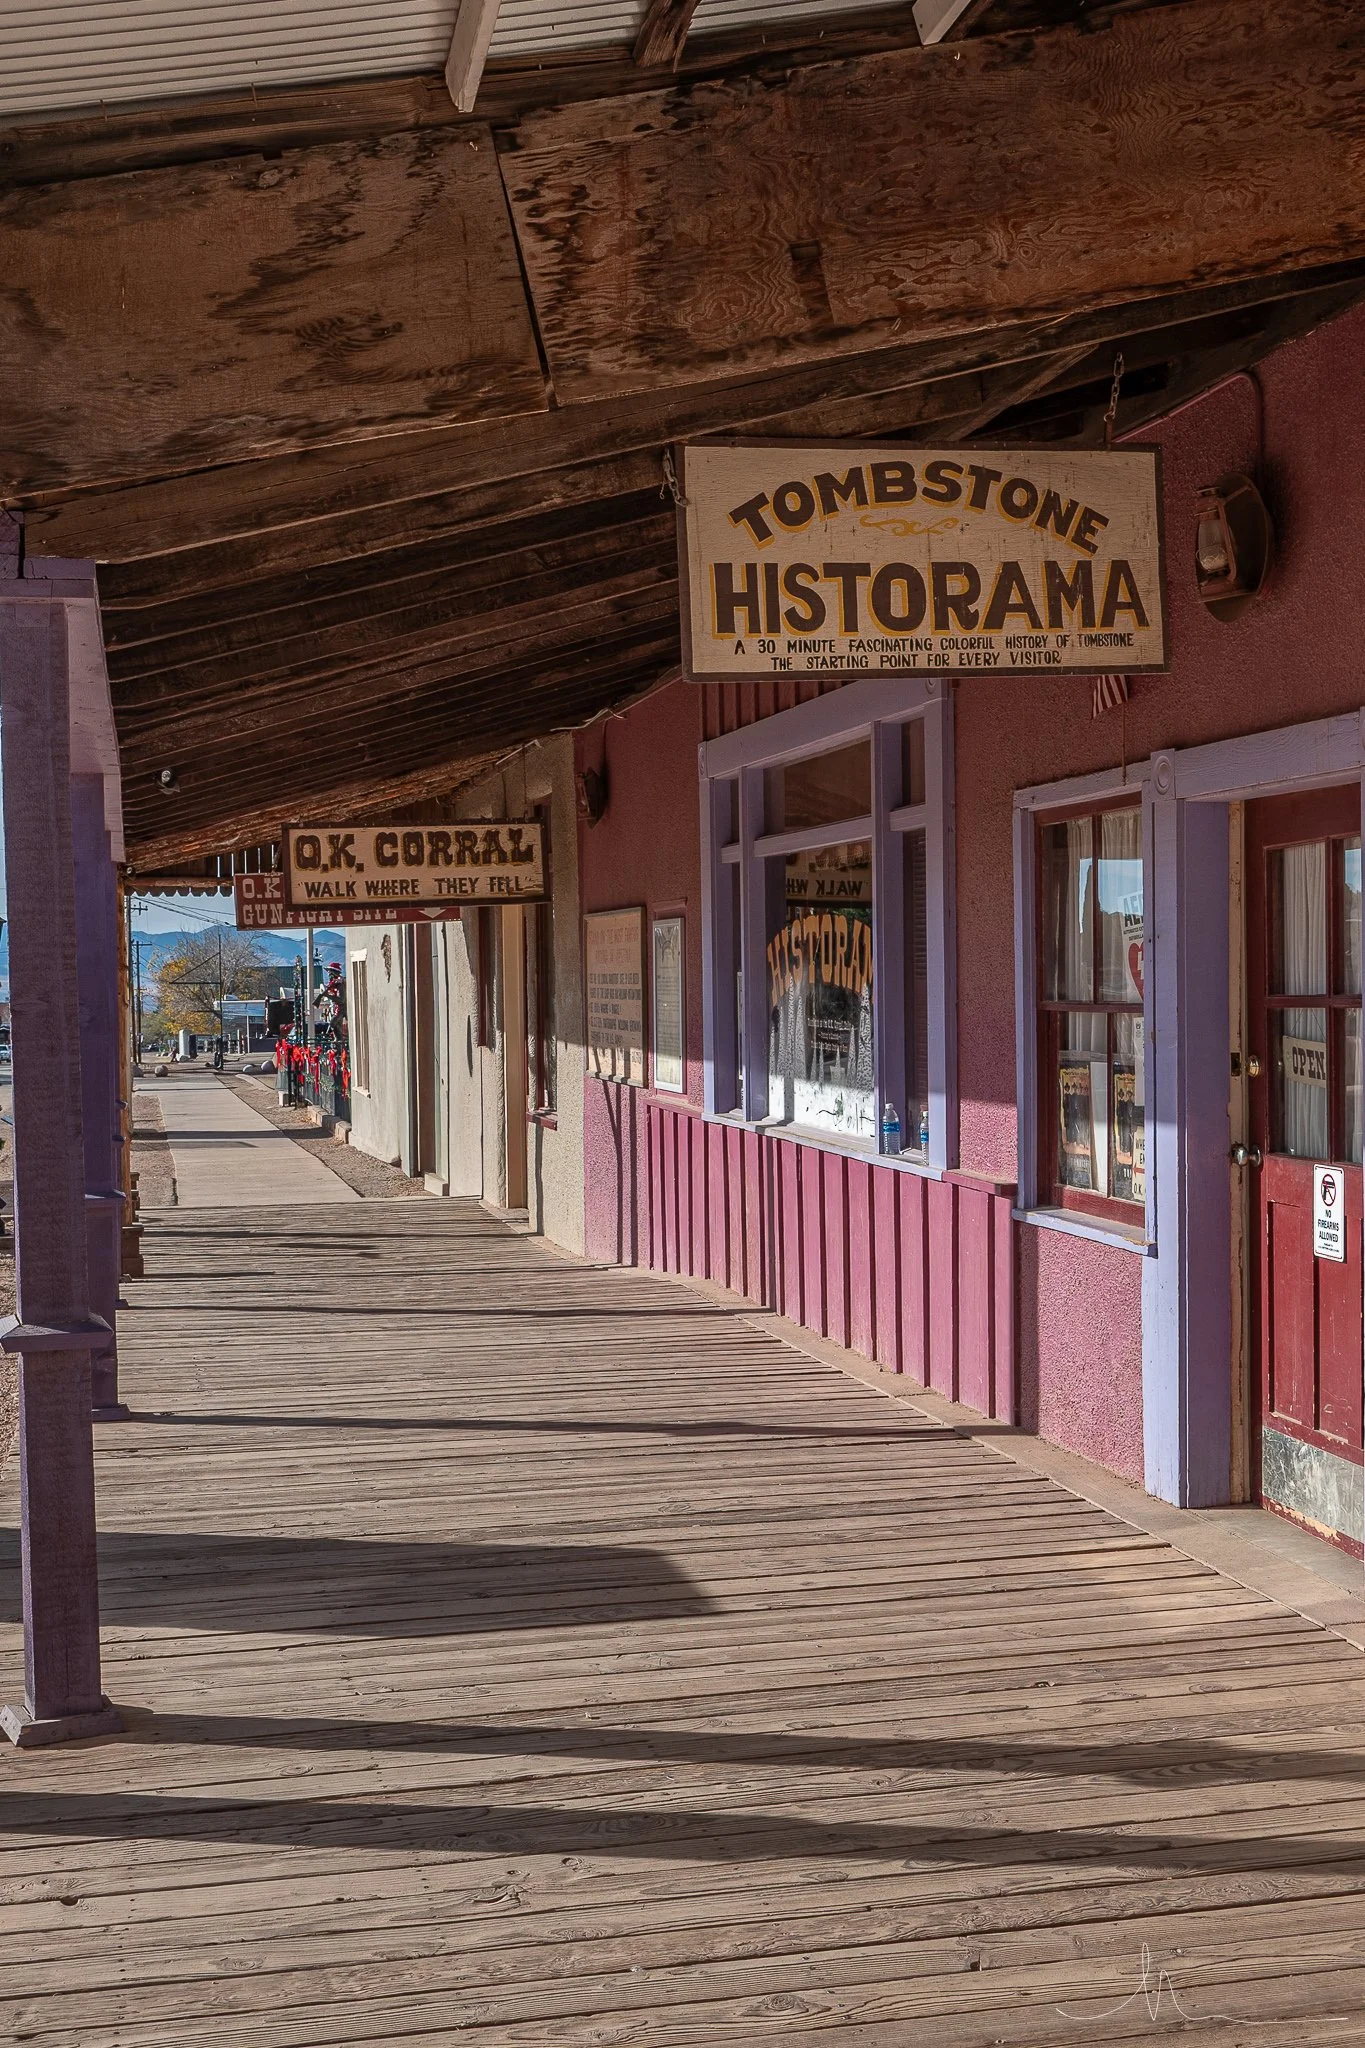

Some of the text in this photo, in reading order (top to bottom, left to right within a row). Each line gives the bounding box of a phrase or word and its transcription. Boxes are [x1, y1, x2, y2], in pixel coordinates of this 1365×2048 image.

[727, 460, 1110, 556] TOMBSTONE
[709, 559, 1150, 640] HISTORAMA
[734, 632, 1135, 655] A 30 MINUTE FASCINATING COLORFUL HISTORY OF TOMBSTONE
[771, 650, 1063, 671] THE STARTING POINT FOR EVERY VISITOR
[294, 828, 534, 873] O.K. CORRAL
[365, 879, 420, 896] WHERE
[432, 877, 480, 894] THEY
[1292, 1046, 1326, 1080] OPEN
[1317, 1218, 1340, 1231] FIREARMS
[1325, 1209, 1332, 1218] NO
[1318, 1231, 1339, 1243] ALLOWED
